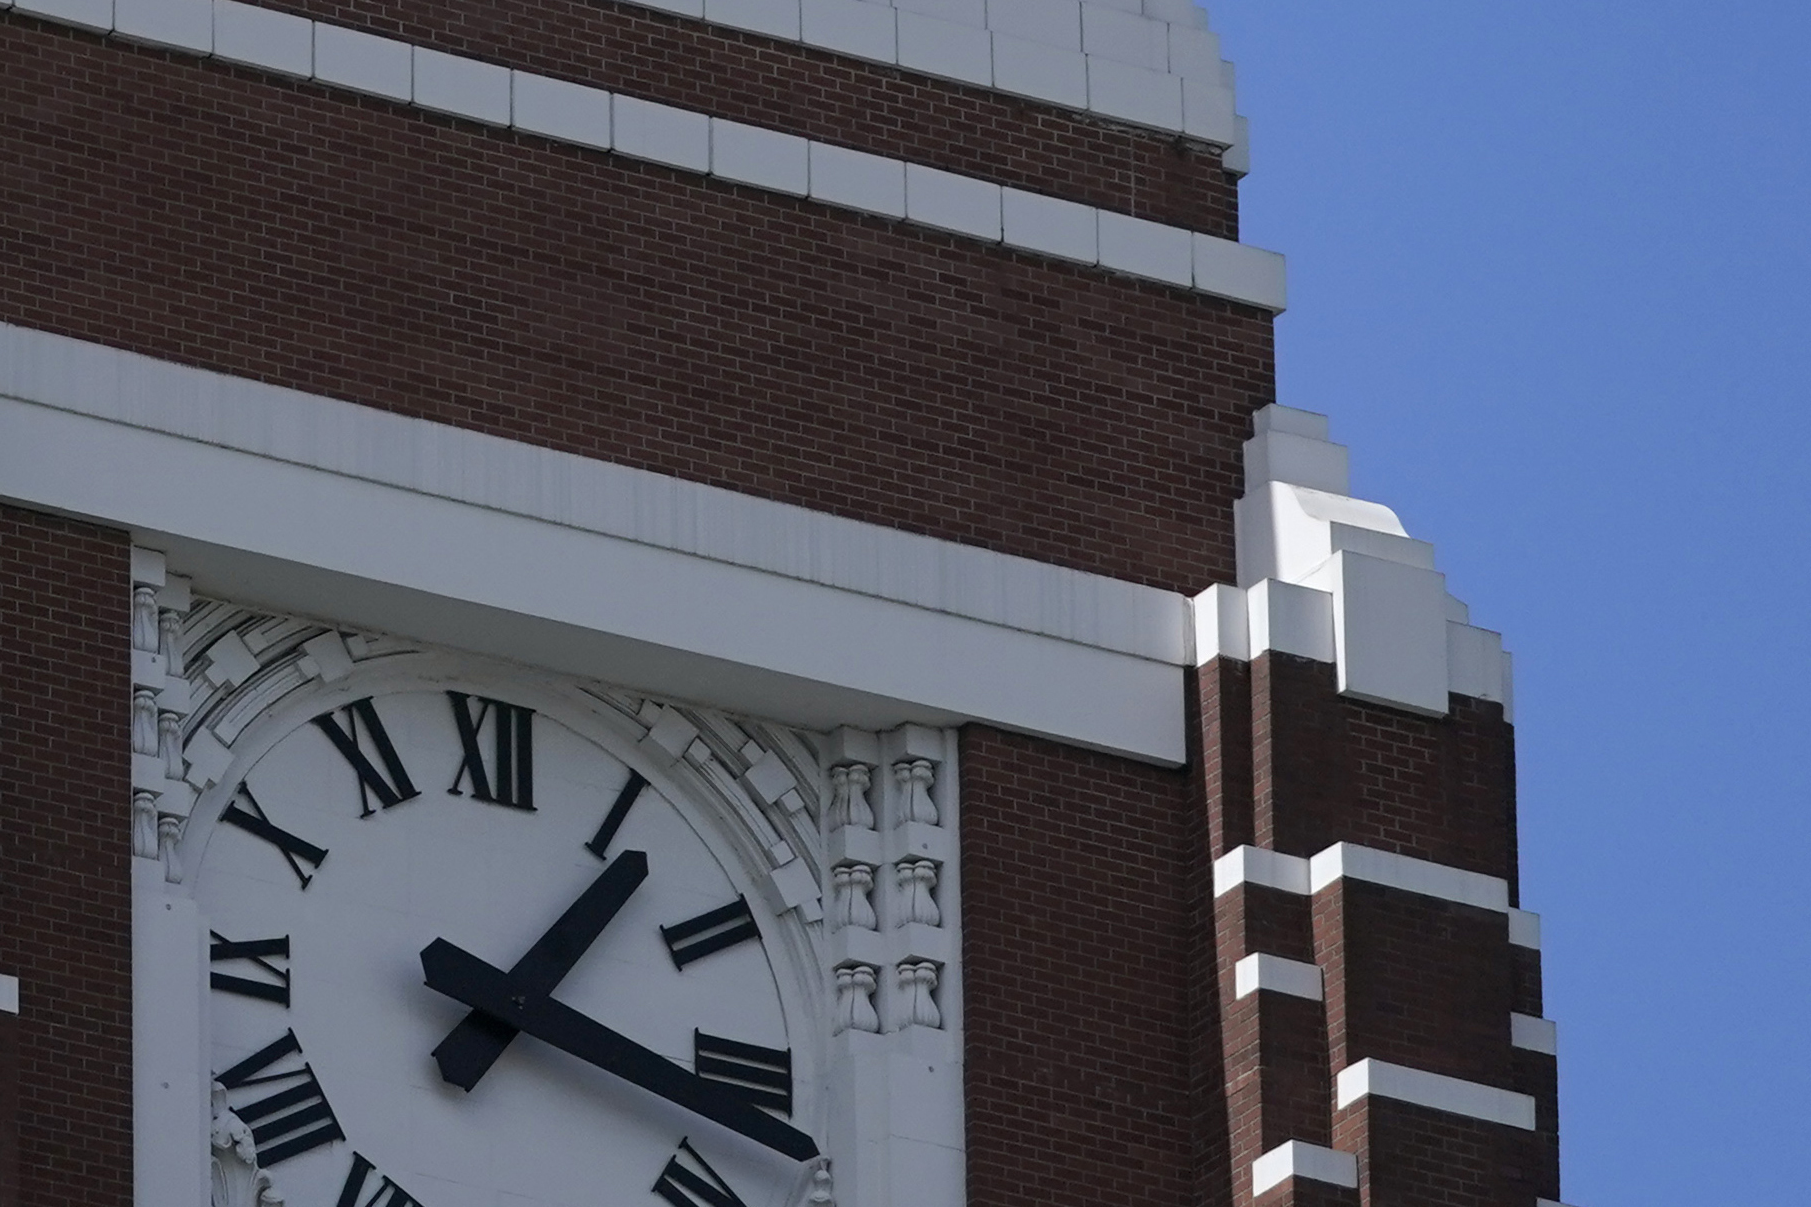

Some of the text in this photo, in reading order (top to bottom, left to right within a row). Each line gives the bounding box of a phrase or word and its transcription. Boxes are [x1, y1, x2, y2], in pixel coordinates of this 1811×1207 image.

[309, 696, 422, 819] XI
[444, 690, 538, 812] XII
[218, 781, 328, 890] X
[585, 768, 651, 861] I
[659, 893, 762, 972] II
[215, 1027, 346, 1168] VIII
